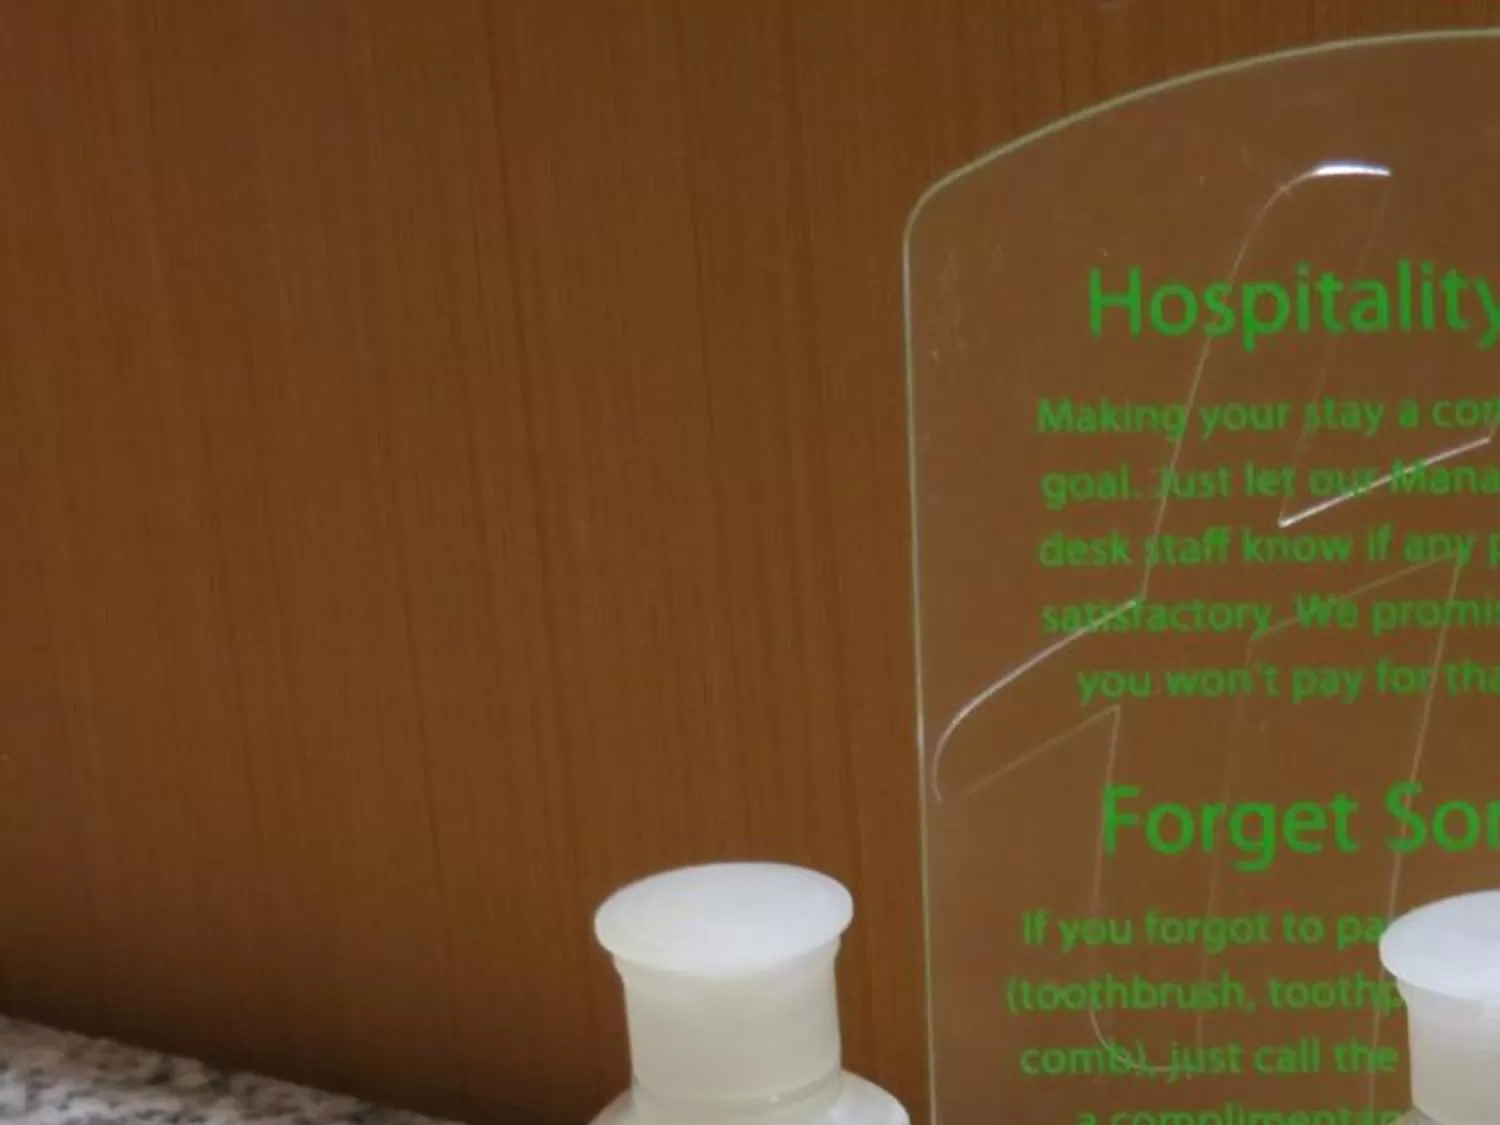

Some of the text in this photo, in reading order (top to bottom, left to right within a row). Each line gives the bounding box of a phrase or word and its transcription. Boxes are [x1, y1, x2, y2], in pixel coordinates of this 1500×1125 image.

[1037, 397, 1186, 444] Making
[1201, 402, 1291, 443] your
[1305, 396, 1383, 436] stay
[1398, 401, 1419, 428] a
[1158, 464, 1231, 498] Just
[1244, 461, 1295, 497] let
[1308, 468, 1378, 498] our
[1038, 529, 1130, 567] desk
[1145, 526, 1230, 565] staff
[1243, 527, 1351, 563] know
[1366, 522, 1393, 560] if
[1404, 532, 1476, 570] any
[1295, 593, 1359, 630] We
[1077, 668, 1151, 705] you
[1165, 661, 1280, 697] won't
[1293, 667, 1362, 703] pay
[1375, 655, 1433, 696] for
[1102, 782, 1359, 872] Forget
[1021, 909, 1048, 945] If
[1058, 917, 1134, 952] you
[1145, 907, 1272, 954] forgot
[1281, 911, 1325, 944] to
[1336, 915, 1382, 950] pa
[1005, 970, 1257, 1015] (toothbrush,
[1267, 971, 1405, 1015] toothp
[1168, 1040, 1242, 1082] just
[1253, 1037, 1321, 1074] call
[1332, 1038, 1398, 1074] the
